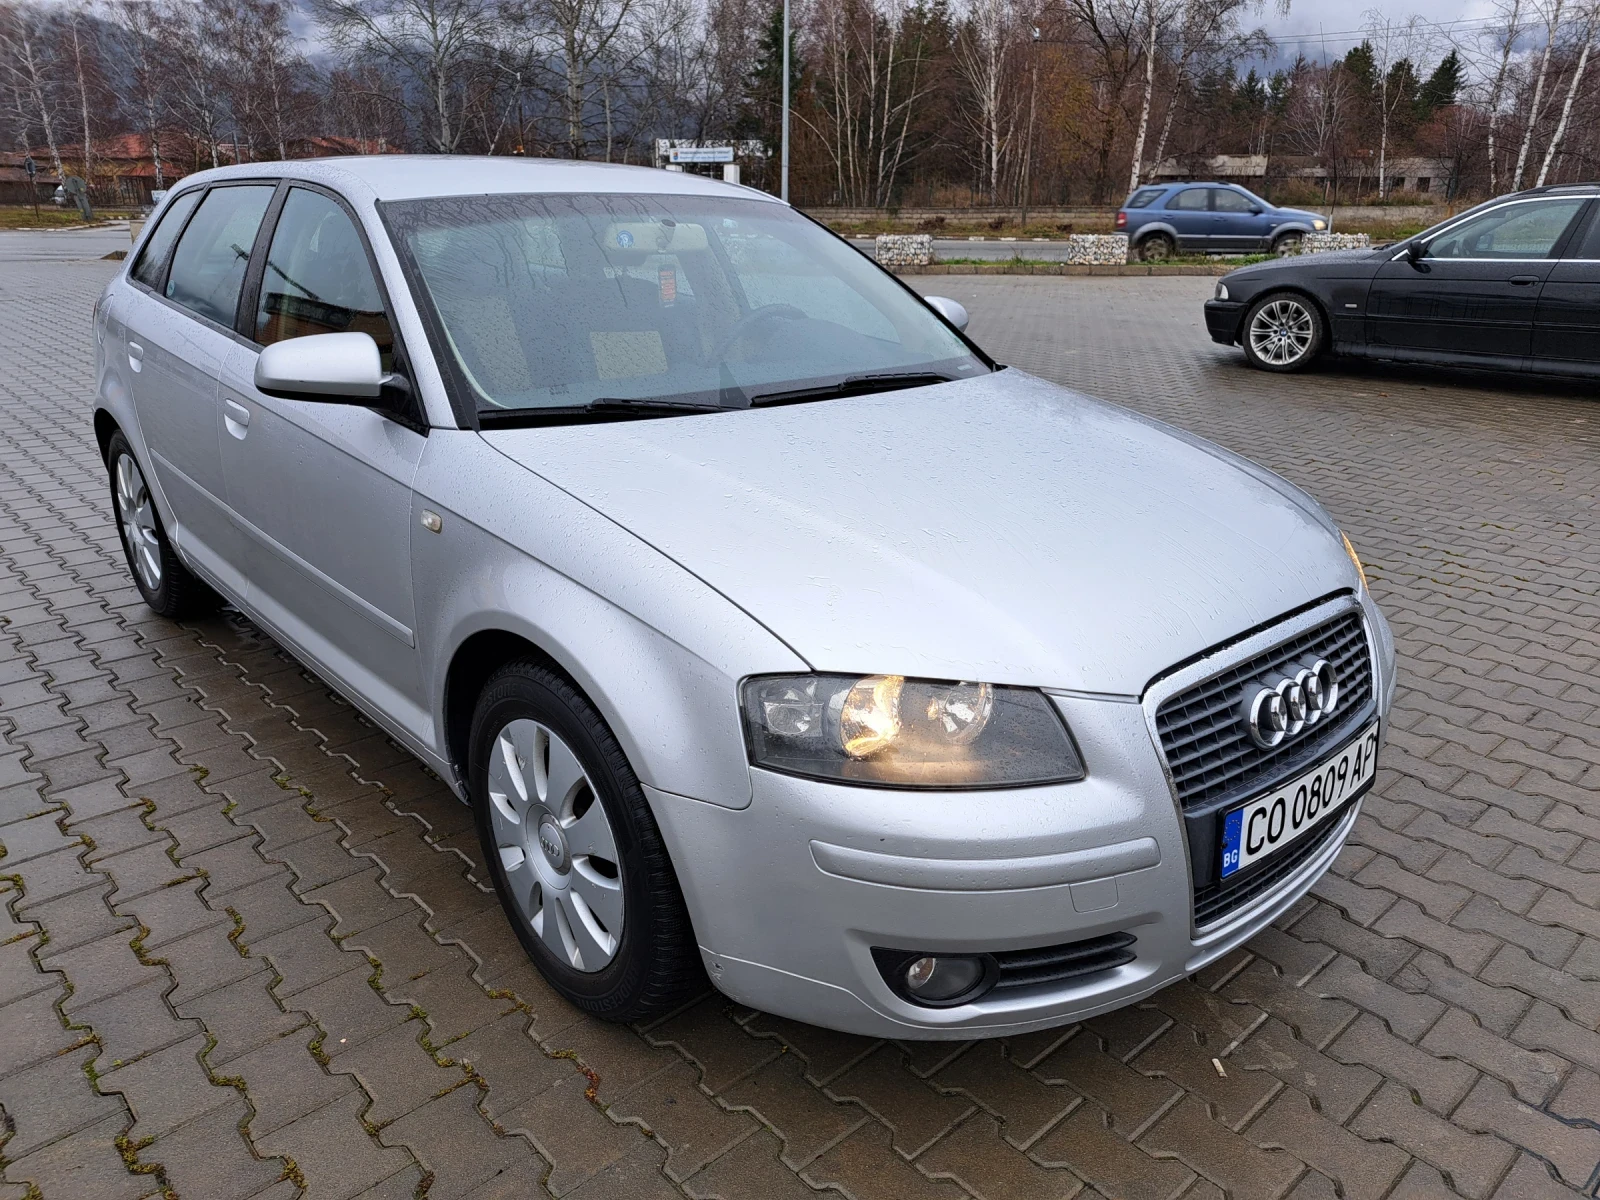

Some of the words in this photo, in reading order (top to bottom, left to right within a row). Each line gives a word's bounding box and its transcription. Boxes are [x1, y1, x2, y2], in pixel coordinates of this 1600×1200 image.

[1246, 797, 1286, 855] CO
[1292, 755, 1349, 830] 0809
[1349, 732, 1374, 789] AP
[1223, 849, 1239, 868] BG
